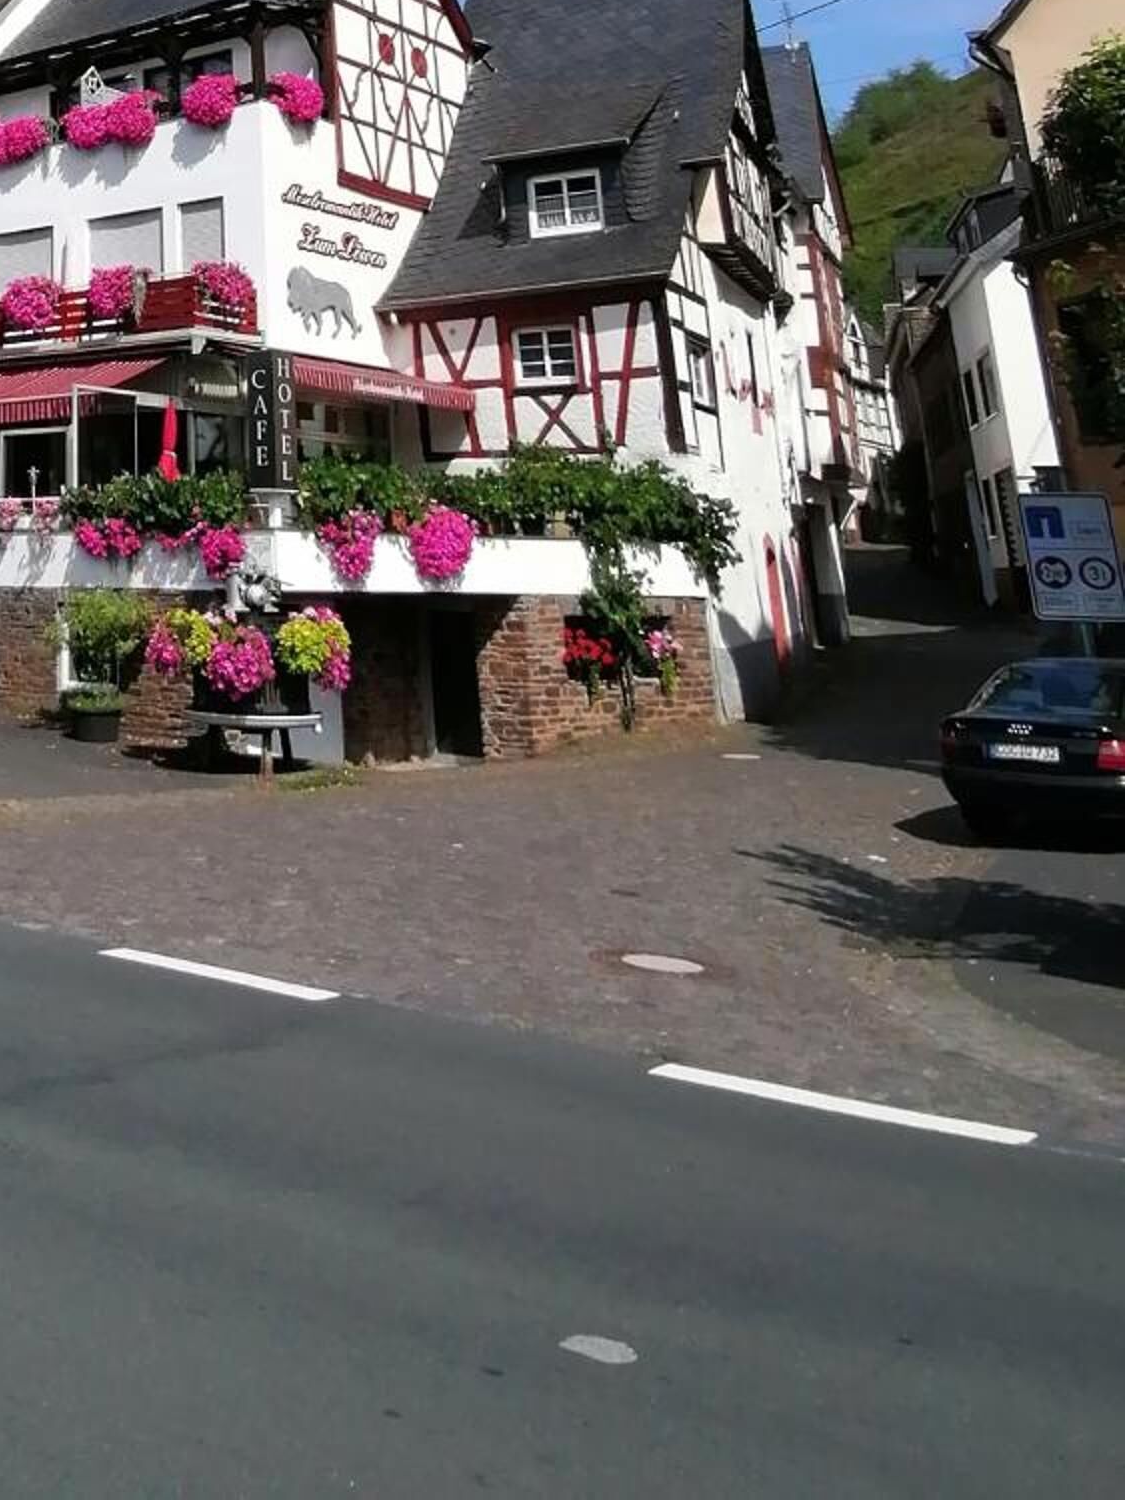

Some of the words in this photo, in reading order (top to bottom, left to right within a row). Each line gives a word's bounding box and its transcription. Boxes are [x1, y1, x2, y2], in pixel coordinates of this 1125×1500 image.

[297, 222, 337, 256] Zum
[338, 232, 387, 268] Löwen
[251, 369, 268, 467] CAFE
[277, 357, 294, 481] HOTEL
